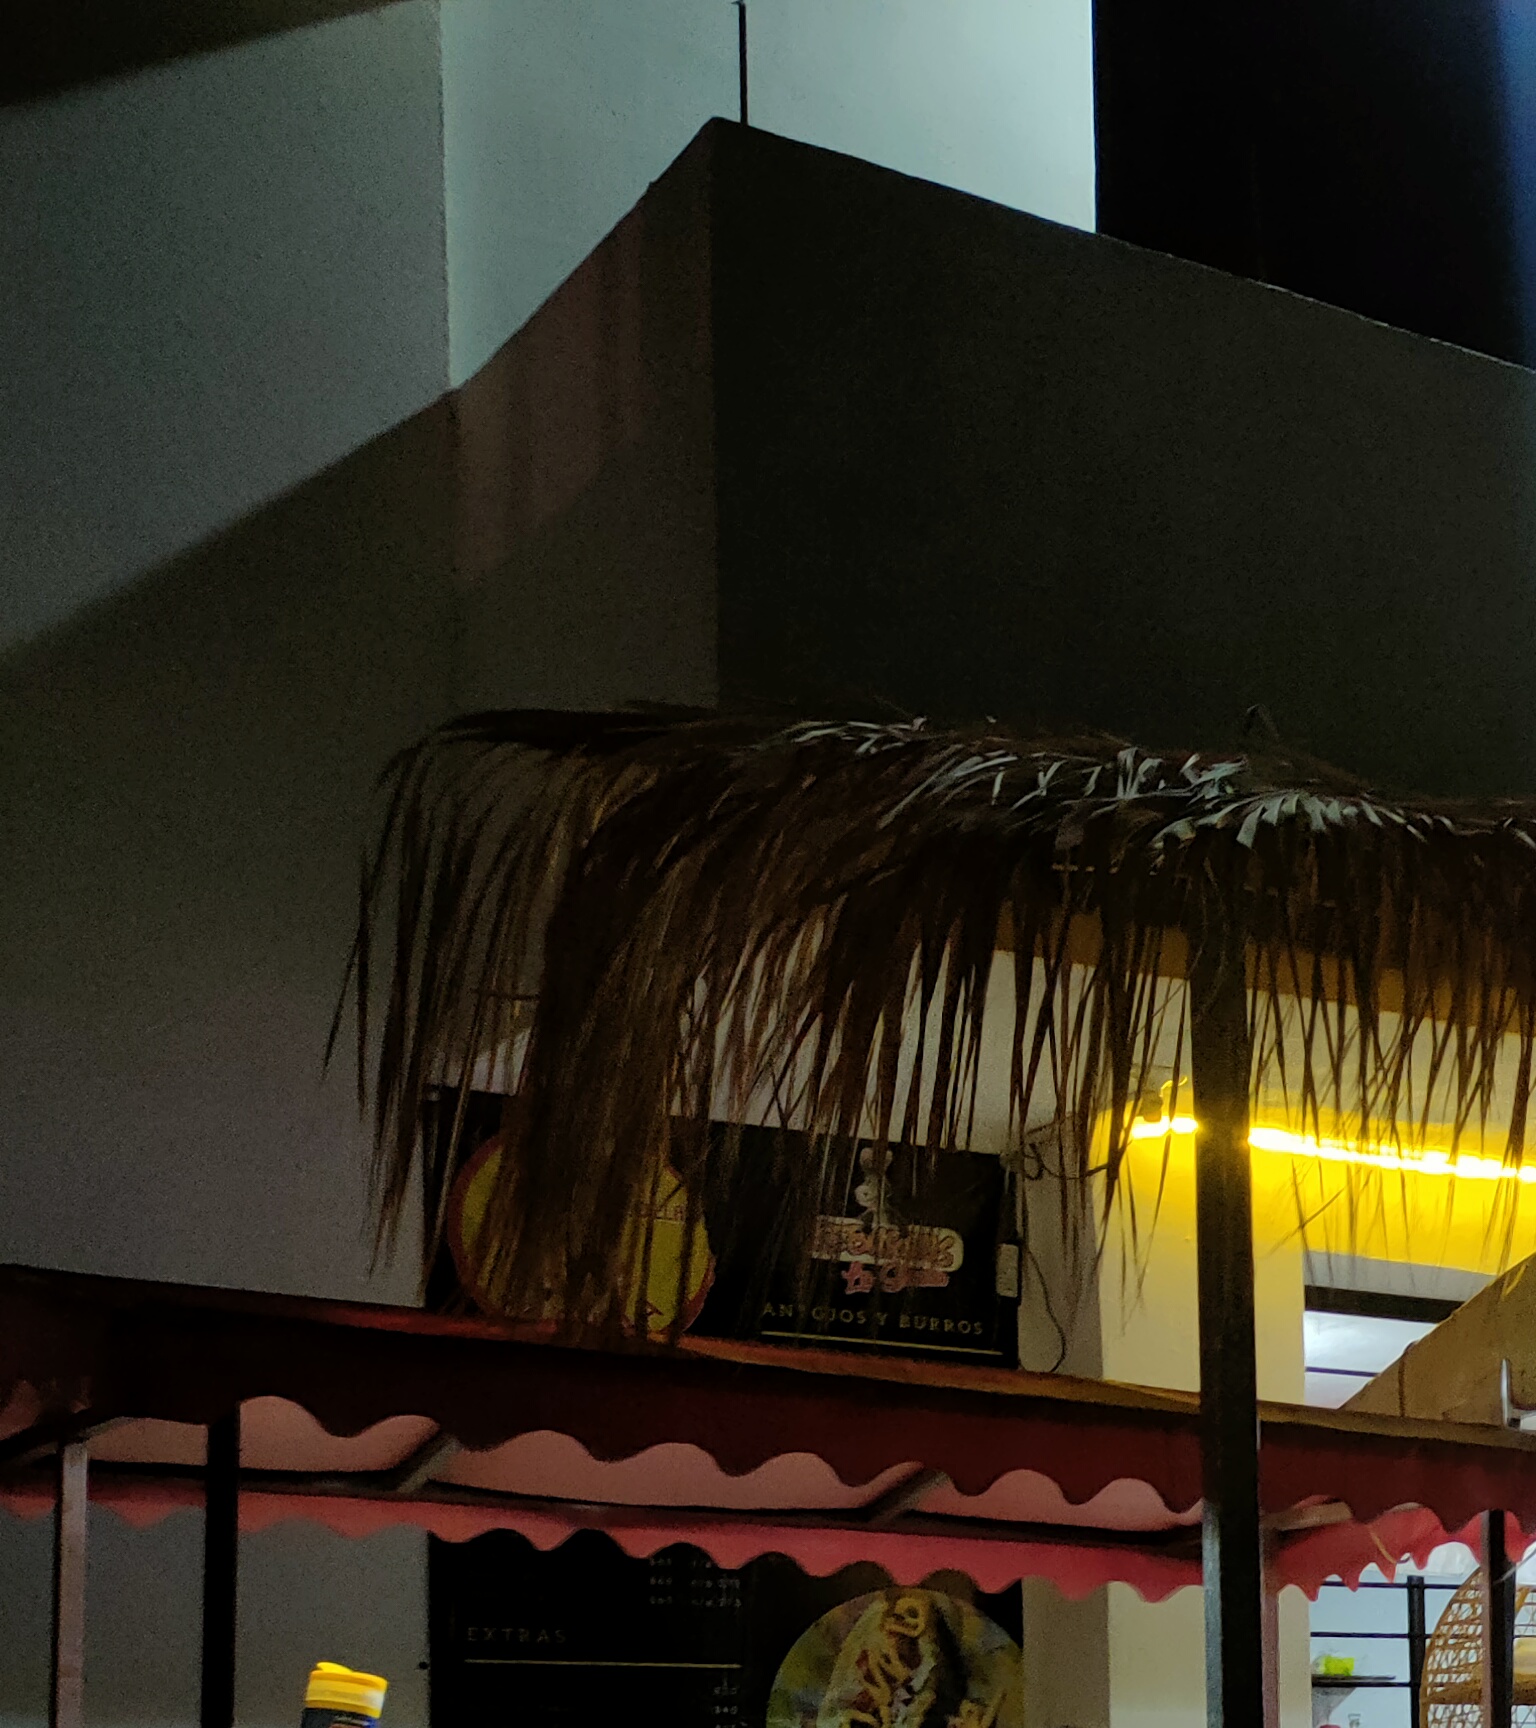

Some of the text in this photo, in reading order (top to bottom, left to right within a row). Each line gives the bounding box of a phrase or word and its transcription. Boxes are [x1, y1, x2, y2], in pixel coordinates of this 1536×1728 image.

[763, 1302, 985, 1336] ANOJOS Y BURROS
[467, 1627, 567, 1643] EXTRAS
